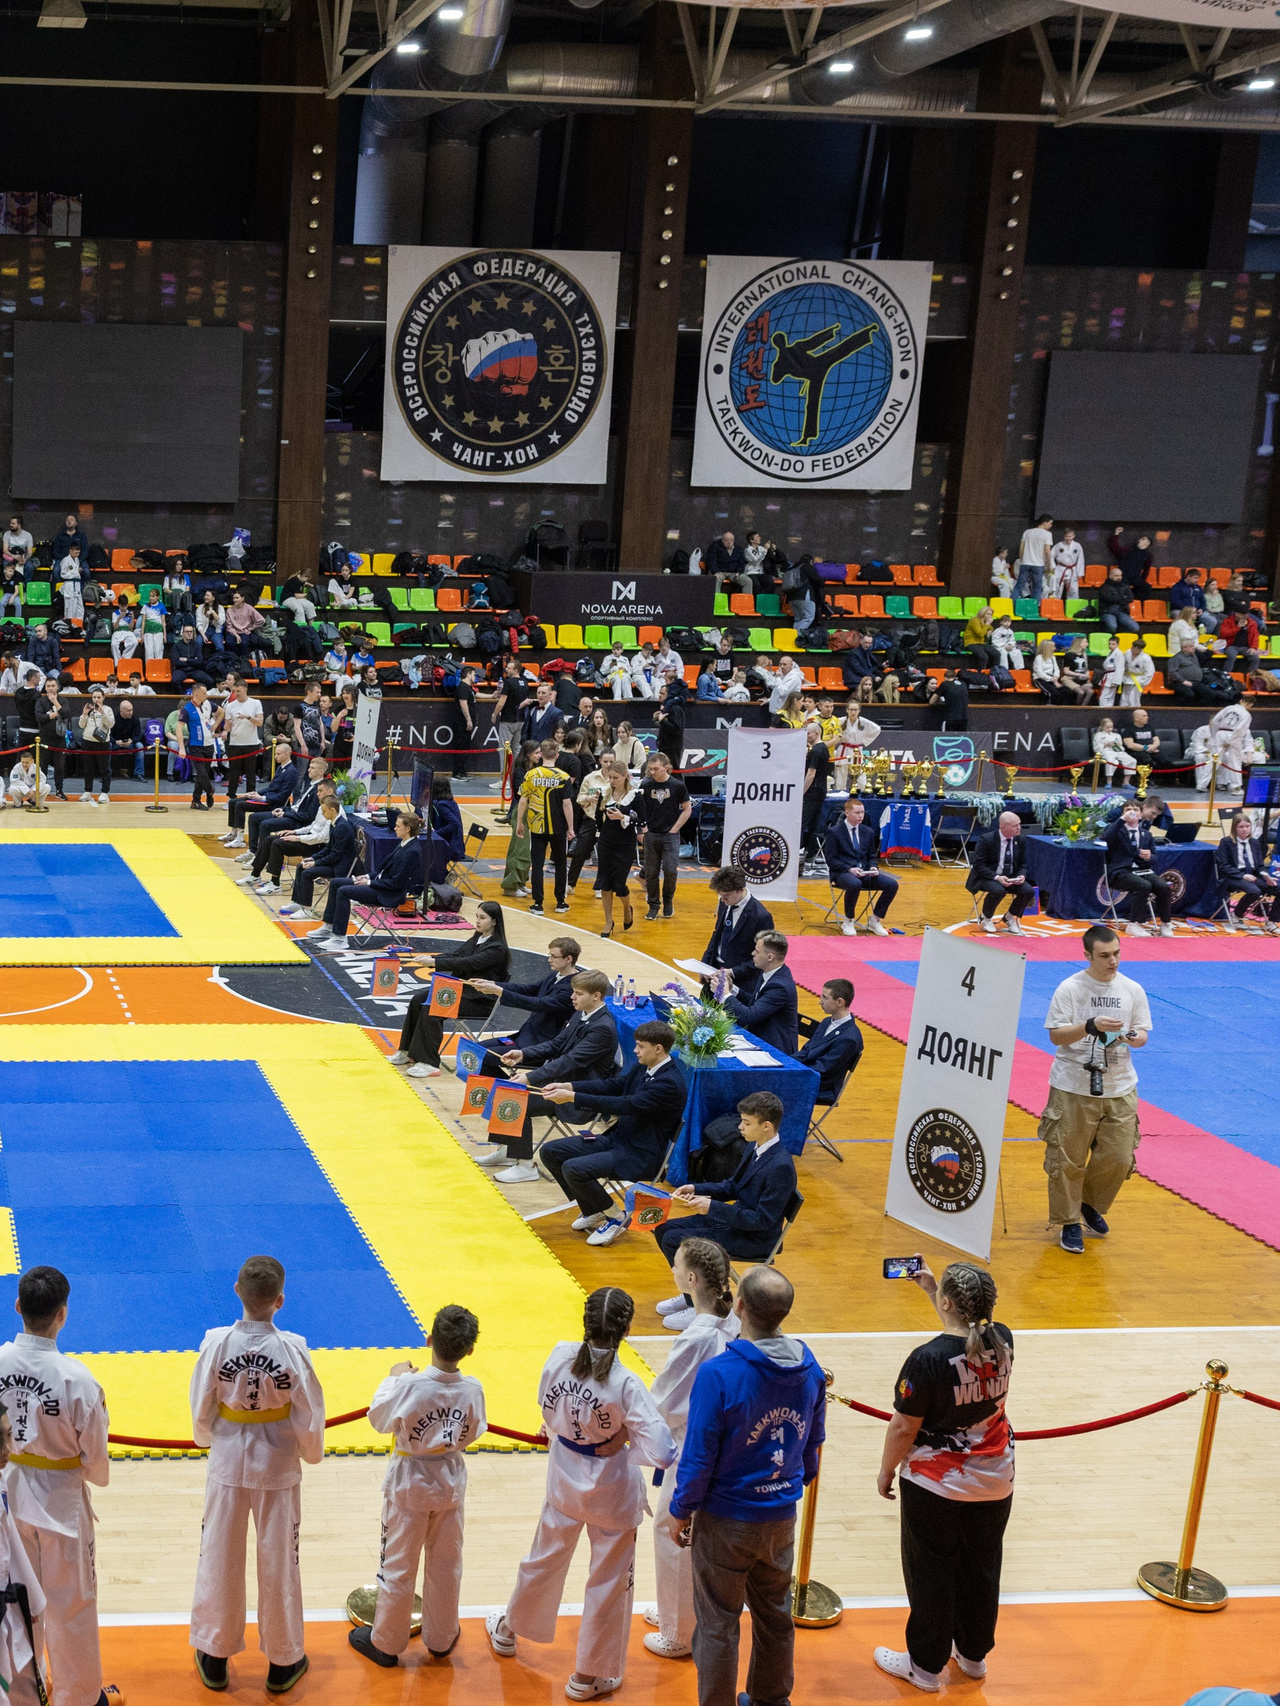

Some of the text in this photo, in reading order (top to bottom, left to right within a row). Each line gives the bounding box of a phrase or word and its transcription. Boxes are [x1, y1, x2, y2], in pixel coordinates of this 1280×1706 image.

[714, 265, 912, 362] INTERNATIONAL CH'ANG-HON
[402, 258, 596, 424] ВСЕРОССИЙСКАЯ ФЕДЕРАЦИЯ ТХЭКВОНДО
[738, 309, 770, 413] 태권도
[716, 394, 903, 473] TAEKWON-DO FEDERATION
[452, 441, 539, 467] ЧАНГ-ХОН
[581, 604, 663, 614] NOVA ARENA
[761, 741, 771, 759] 3
[993, 731, 1056, 752] ENA
[732, 782, 796, 804] ДОЯНГ
[960, 966, 976, 997] 4
[1090, 996, 1122, 1009] NATURE
[917, 1024, 1003, 1081] ДОЯНГ
[908, 1112, 983, 1200] ВСЕРОССИЙСКАЯ ФЕДЕРАЦИЯ ТХЭКВОНДО
[923, 1189, 957, 1211] ЧАНГ-ХОН
[218, 1353, 291, 1390] TAEKWON-DO
[16, 1390, 31, 1399] ITF
[543, 1380, 611, 1430] TAEKWON-DO
[14, 1399, 29, 1442] 태권도
